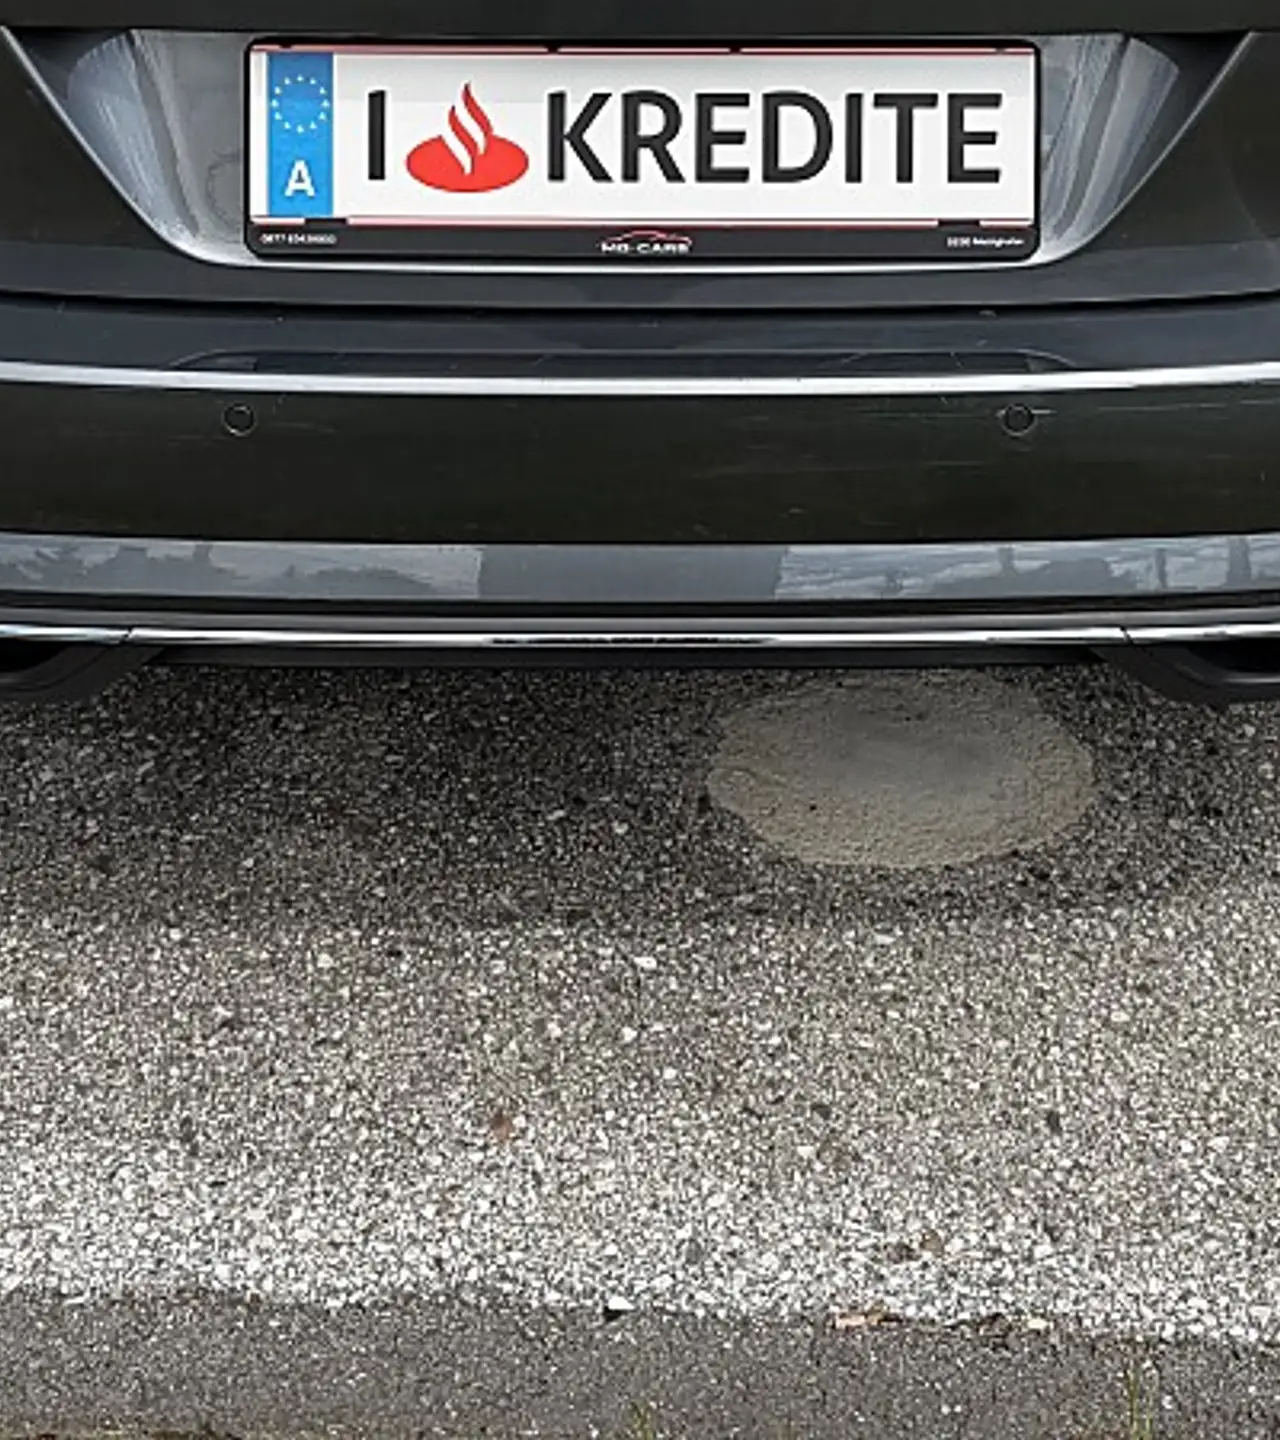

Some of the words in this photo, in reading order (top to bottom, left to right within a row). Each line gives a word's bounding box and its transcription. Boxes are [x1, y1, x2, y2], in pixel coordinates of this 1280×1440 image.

[367, 89, 387, 181] I
[546, 89, 1003, 184] KREDITE
[284, 160, 316, 198] A
